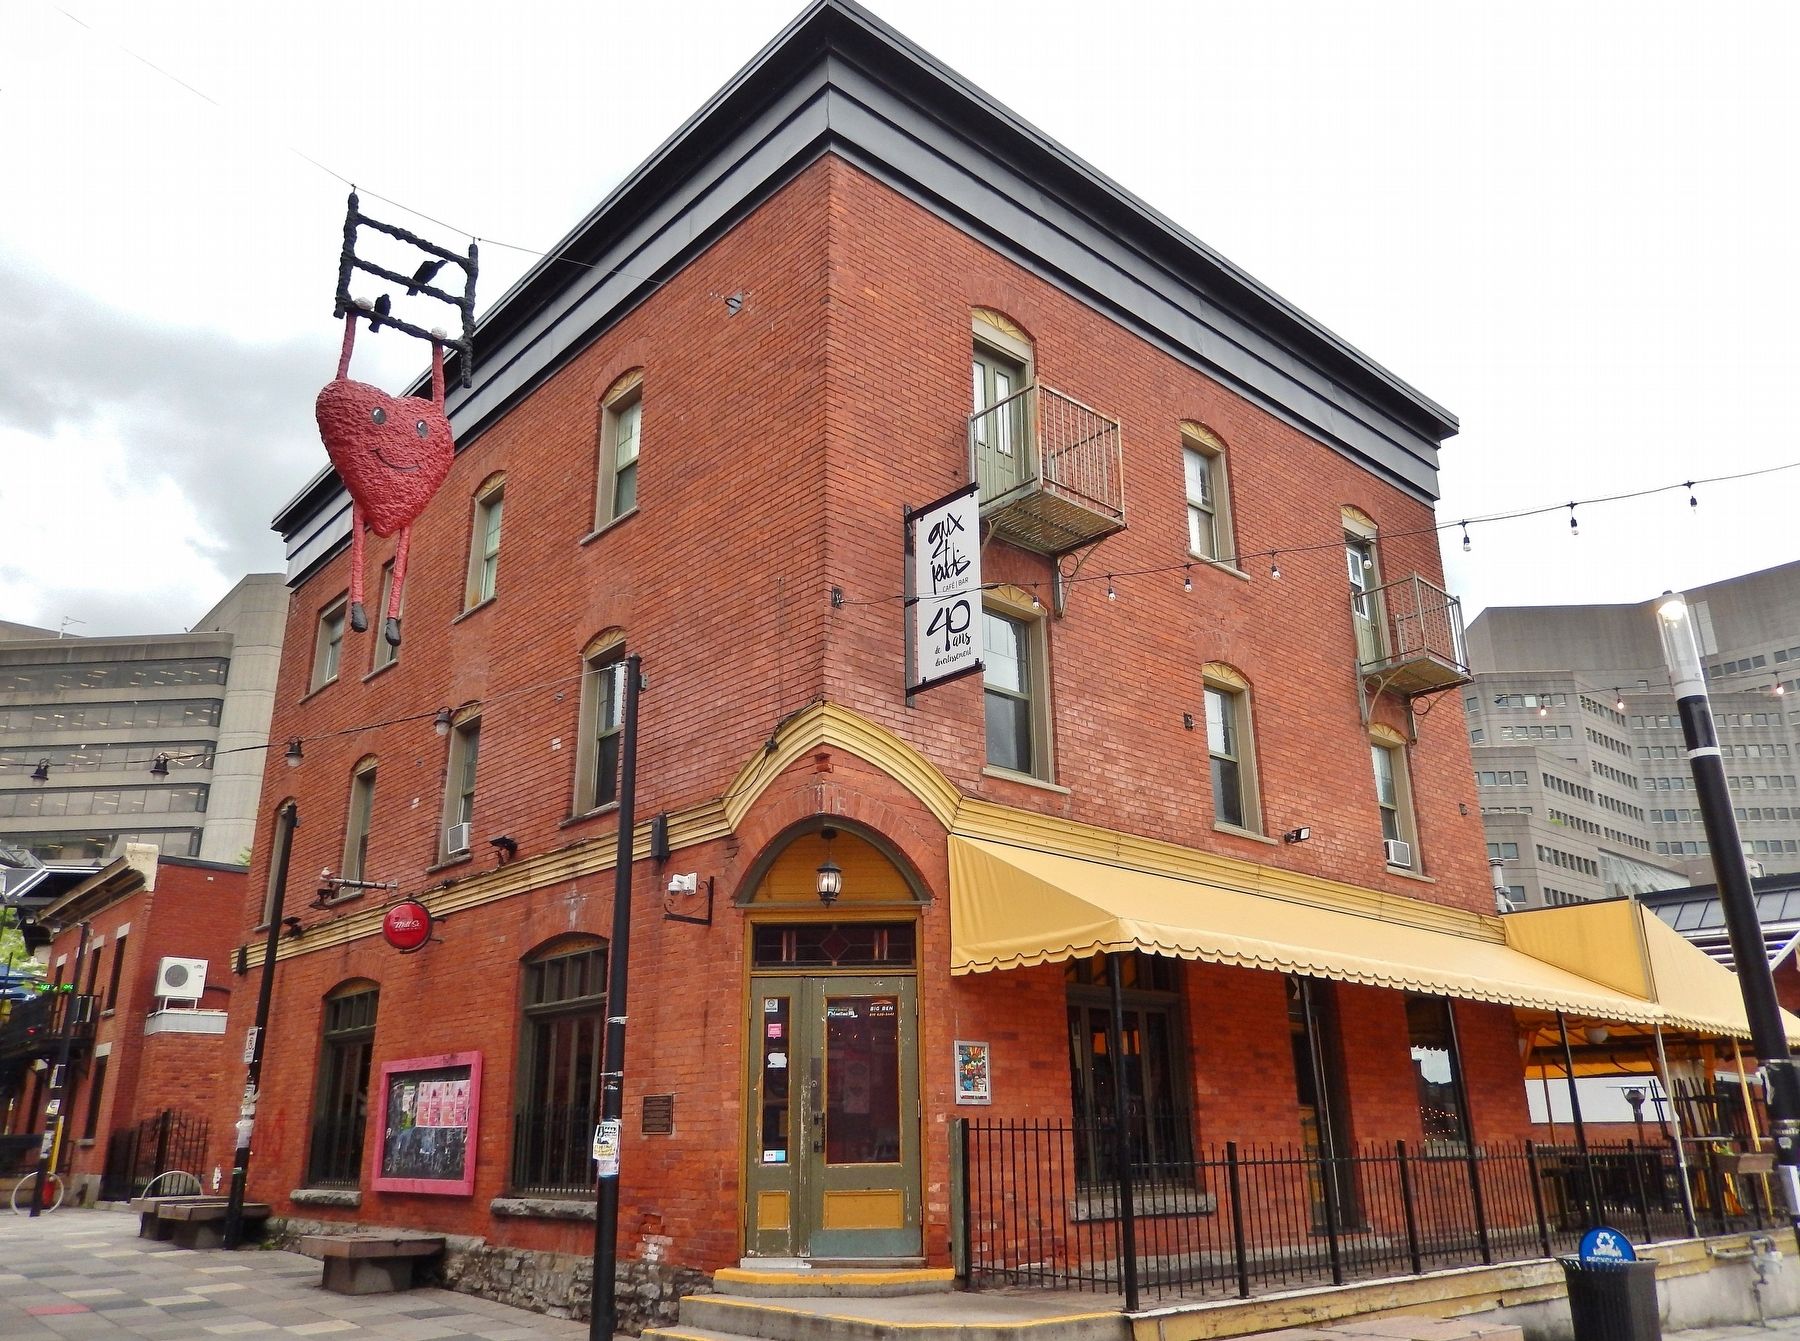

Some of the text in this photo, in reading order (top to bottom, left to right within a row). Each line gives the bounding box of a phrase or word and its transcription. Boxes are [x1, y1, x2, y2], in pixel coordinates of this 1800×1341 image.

[928, 512, 965, 545] aux
[931, 538, 951, 562] 4
[958, 577, 969, 587] BAR
[926, 599, 971, 651] 40
[952, 632, 971, 647] ans
